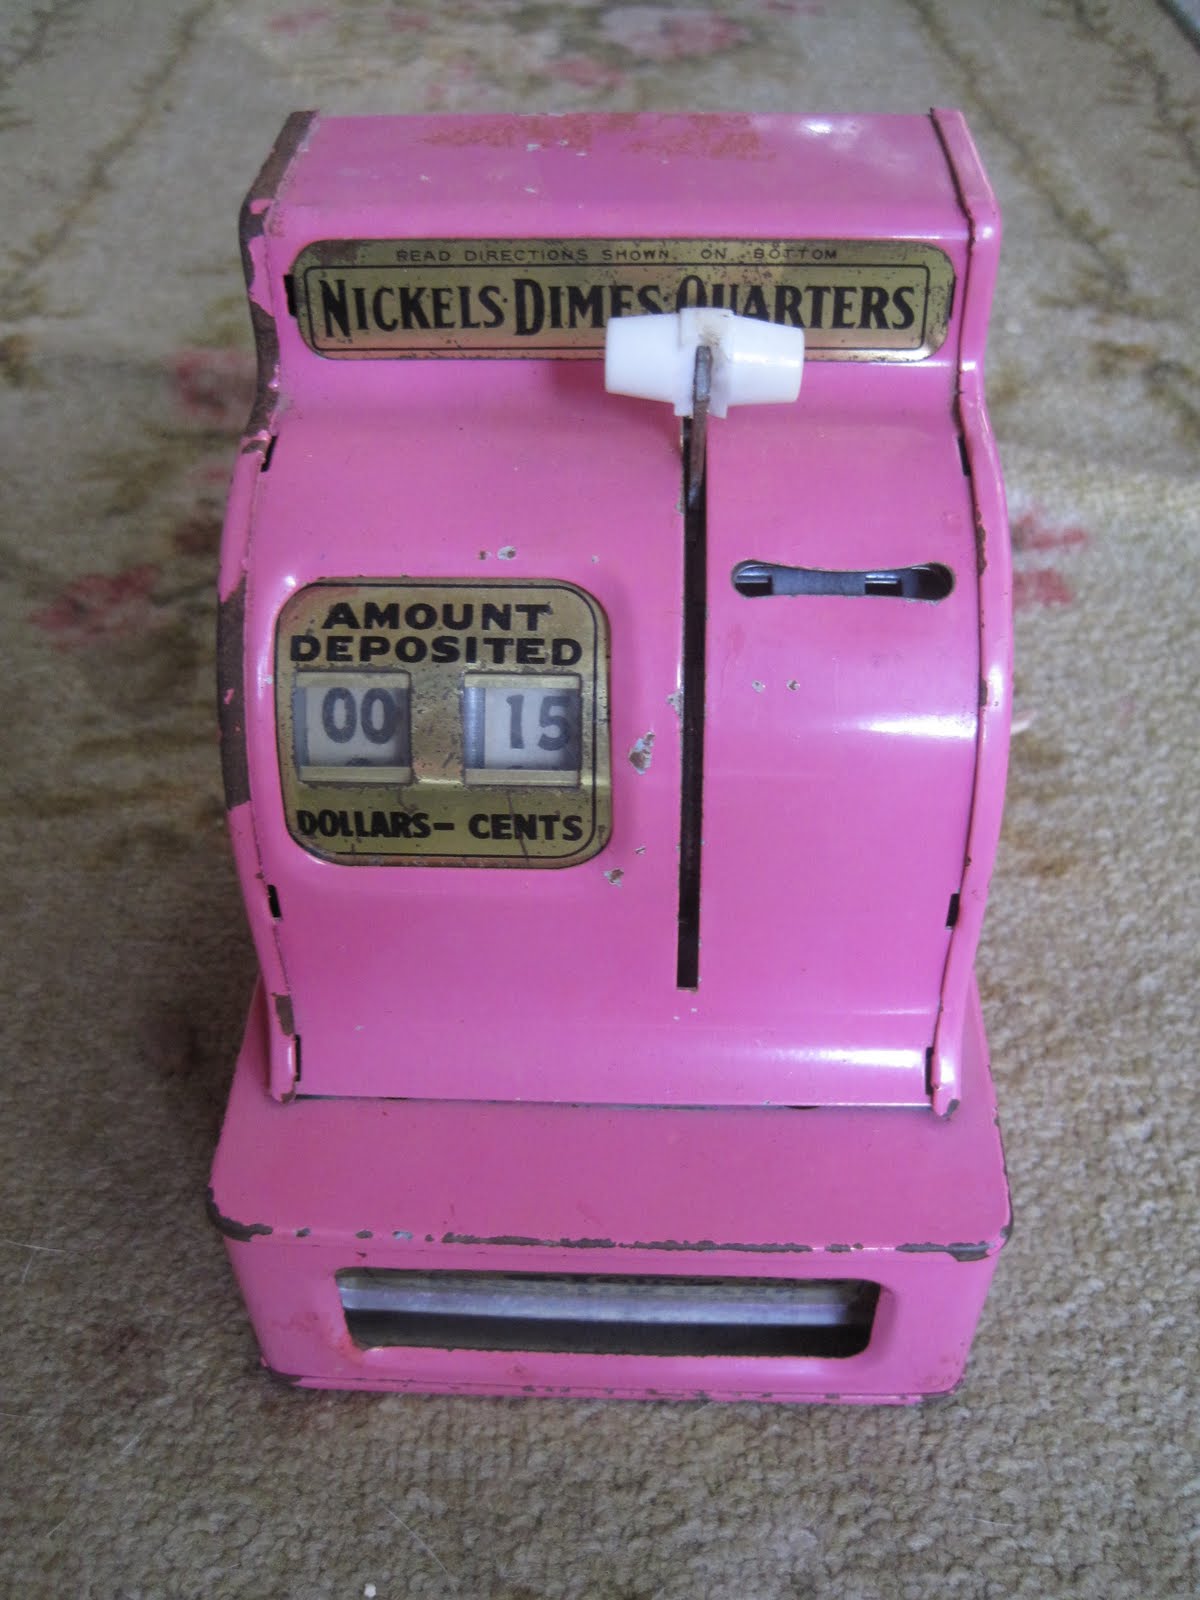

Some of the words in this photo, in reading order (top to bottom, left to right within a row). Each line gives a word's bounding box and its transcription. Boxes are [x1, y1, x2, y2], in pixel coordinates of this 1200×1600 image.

[395, 249, 451, 262] READ
[464, 249, 589, 262] DIRECTIONS
[601, 248, 670, 261] SHOWN
[701, 248, 727, 260] ON
[753, 248, 838, 260] BOTTOM
[321, 601, 553, 632] AMOUNT
[290, 634, 583, 667] DEPOSITED
[321, 686, 399, 745] 00
[505, 693, 575, 752] 15
[467, 813, 584, 841] CENTS
